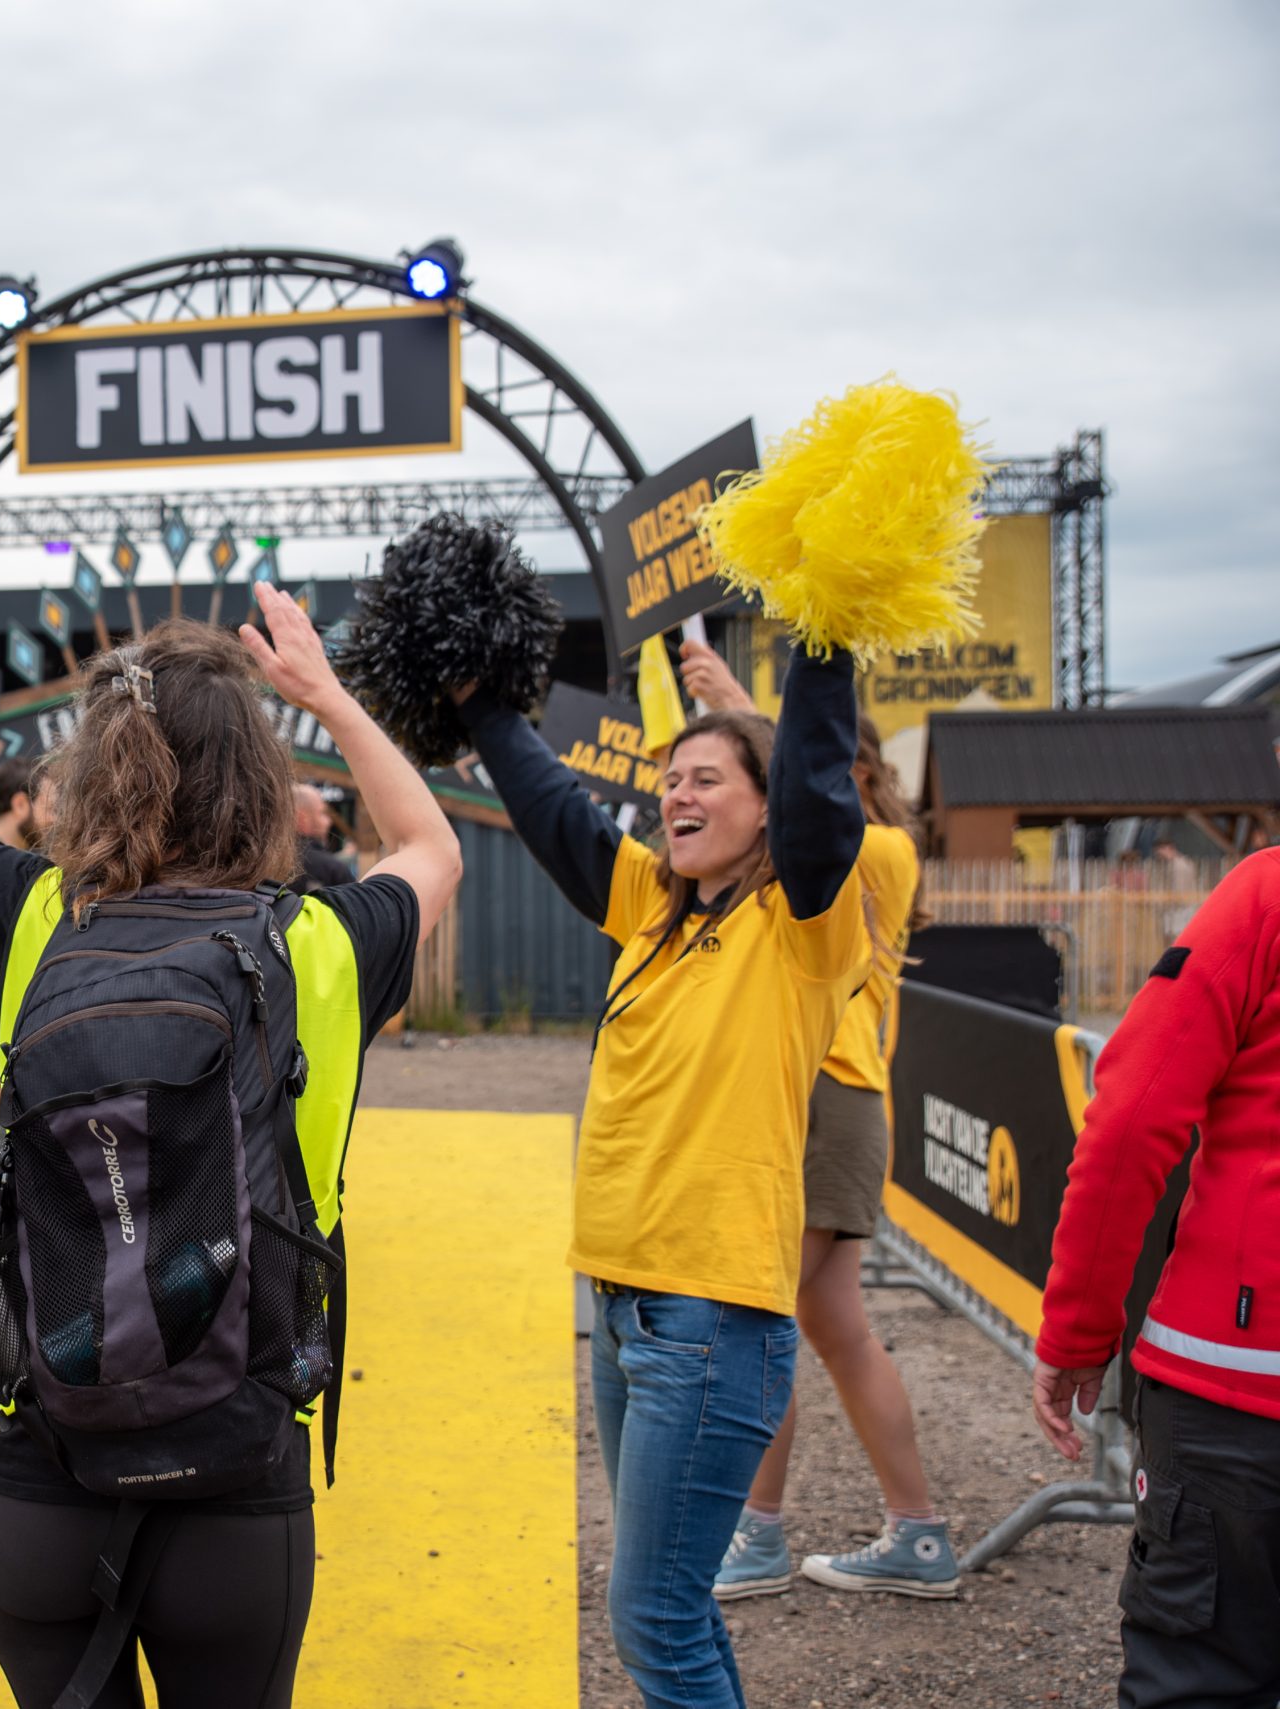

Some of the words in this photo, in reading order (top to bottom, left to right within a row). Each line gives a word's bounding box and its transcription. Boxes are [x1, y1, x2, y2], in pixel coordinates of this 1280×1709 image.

[75, 331, 384, 448] FINISH
[626, 557, 672, 619] JAAR
[558, 740, 633, 785] JAAR
[102, 1147, 136, 1244] CERROTORRE
[118, 1474, 154, 1484] PORTER
[155, 1470, 184, 1481] HIKER
[184, 1467, 196, 1476] 30
